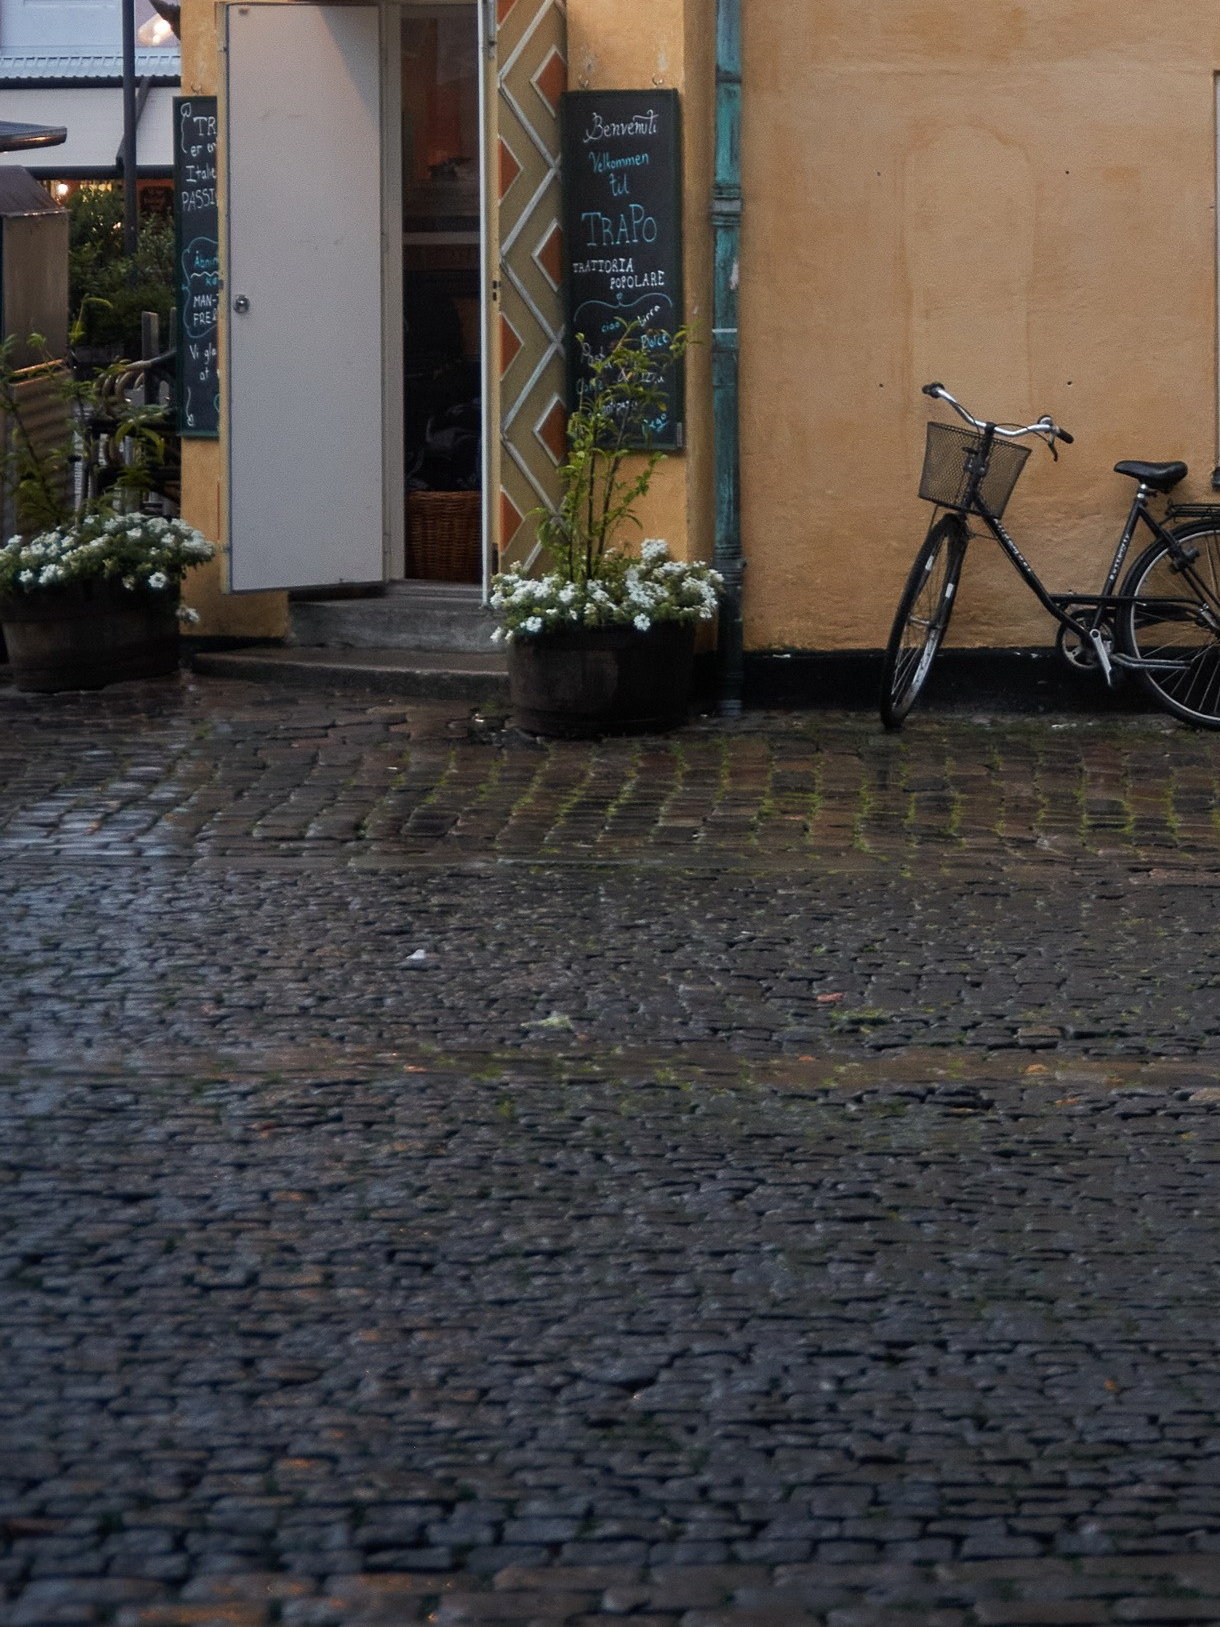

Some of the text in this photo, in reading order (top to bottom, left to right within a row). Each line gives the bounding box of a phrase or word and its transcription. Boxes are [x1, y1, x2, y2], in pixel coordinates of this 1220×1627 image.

[583, 109, 659, 143] Benvenuti
[588, 151, 650, 173] Velkommen
[609, 173, 630, 197] til
[572, 257, 634, 274] TRATTORIA
[609, 269, 665, 290] POPOLARE
